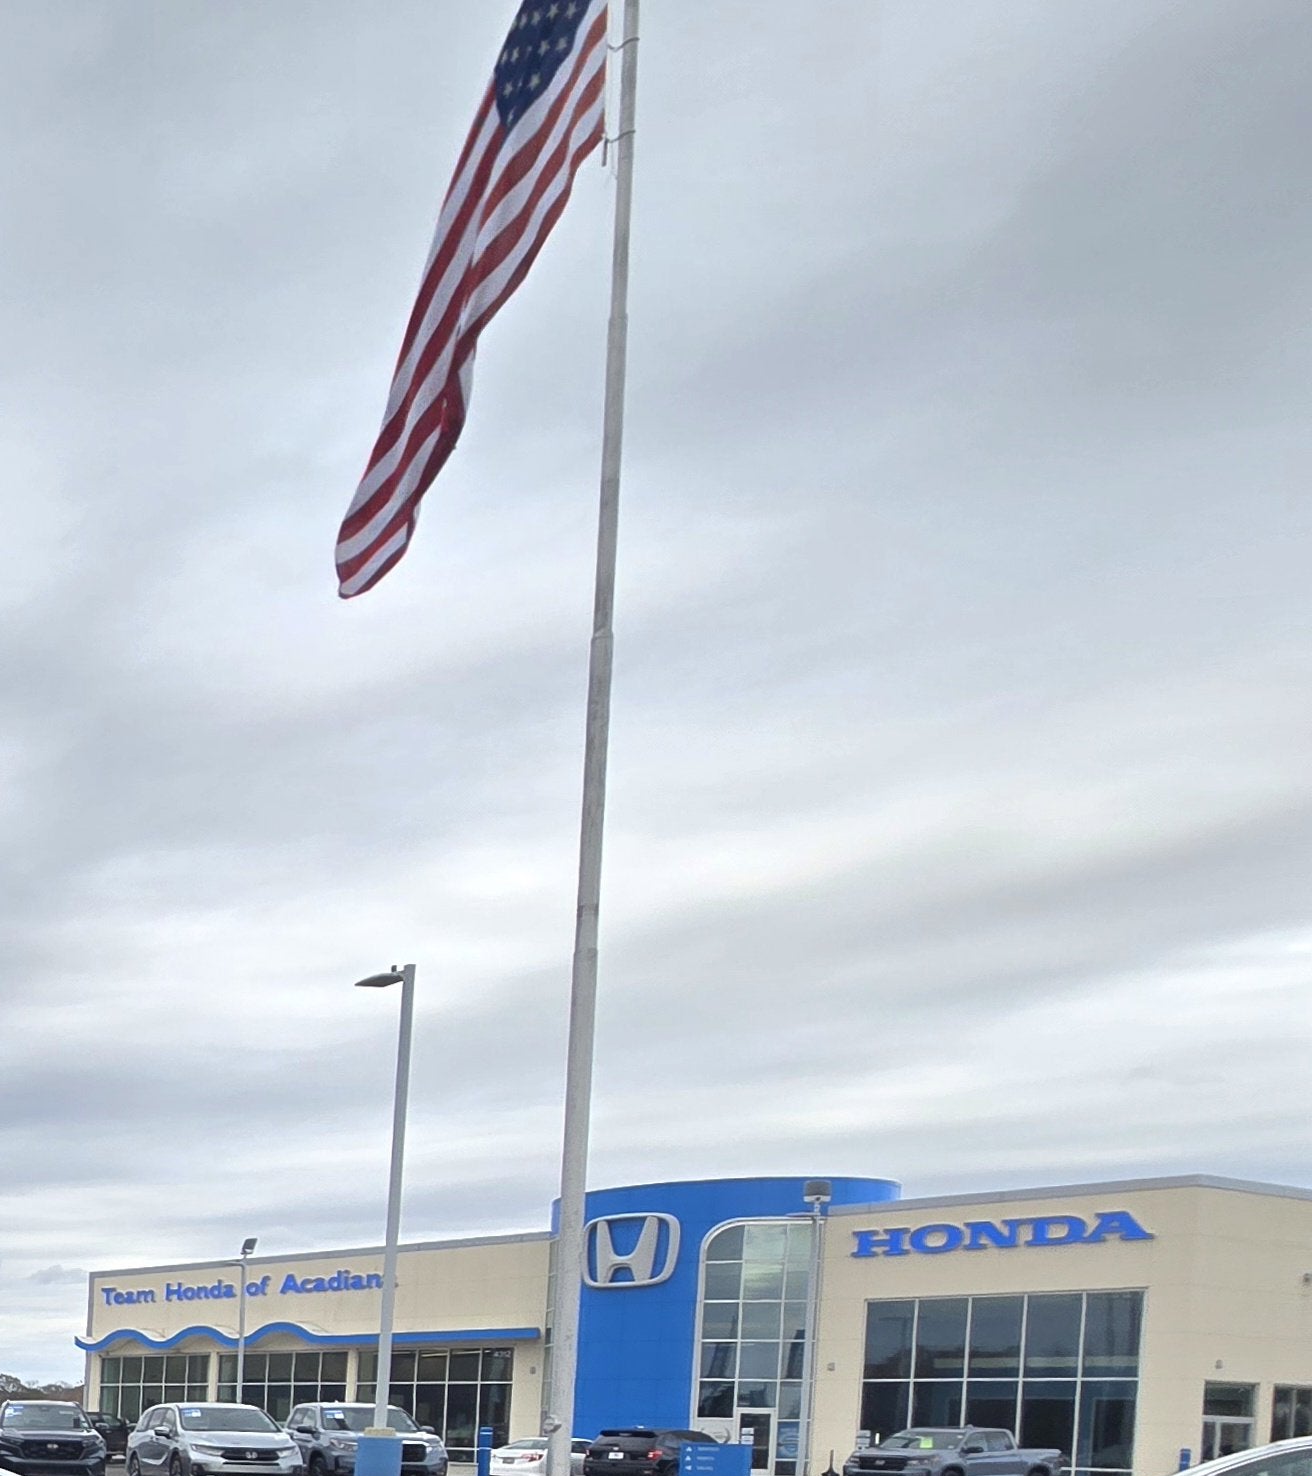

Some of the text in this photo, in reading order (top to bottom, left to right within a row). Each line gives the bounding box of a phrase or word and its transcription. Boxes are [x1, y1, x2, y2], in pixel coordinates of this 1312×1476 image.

[851, 1211, 1154, 1258] HONDA
[101, 1270, 398, 1306] Team Honda of Acadian
